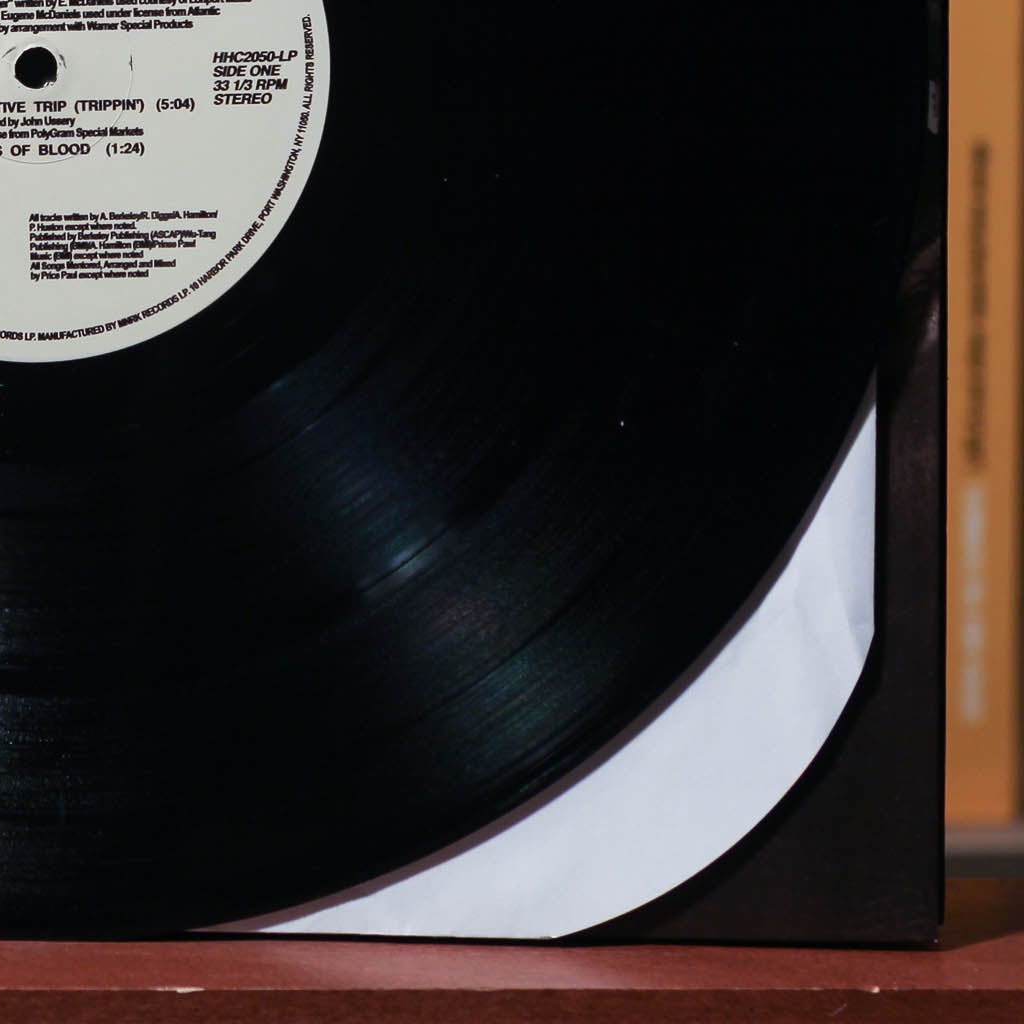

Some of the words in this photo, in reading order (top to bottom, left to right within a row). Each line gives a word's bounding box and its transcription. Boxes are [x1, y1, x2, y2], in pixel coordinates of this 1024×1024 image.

[1, 10, 35, 22] Eugene
[36, 9, 81, 20] McDaniels
[83, 9, 104, 18] used
[106, 8, 132, 18] under
[133, 7, 164, 17] license
[165, 7, 186, 17] from
[187, 6, 221, 16] Atlantic
[10, 22, 66, 34] arrangement
[67, 21, 85, 31] with
[87, 21, 119, 31] Warner
[120, 19, 152, 32] Special
[153, 19, 193, 29] Products
[302, 14, 315, 60] RESERVED.
[212, 50, 298, 64] HHC2050-LP
[212, 65, 247, 77] SIDE
[249, 64, 281, 76] ONE
[304, 61, 315, 93] RIGHTS
[212, 80, 231, 92] 33
[234, 79, 253, 91] 1/3
[255, 78, 288, 91] RPM
[33, 100, 67, 113] TRIP
[74, 98, 145, 114] (TRIPPIN')
[155, 97, 195, 112] (5:04)
[213, 93, 273, 106] STEREO
[302, 93, 313, 110] ALL
[8, 117, 20, 129] by
[20, 116, 43, 127] John
[44, 116, 76, 127] Ussery
[8, 129, 29, 139] from
[31, 128, 74, 141] PolyGram
[76, 128, 107, 139] Special
[109, 127, 144, 137] Markets
[293, 134, 305, 147] NY
[10, 144, 31, 156] OF
[38, 143, 91, 156] BLOOD
[106, 142, 145, 156] (1:24)
[270, 148, 302, 201] WASHINGTON,
[89, 212, 99, 223] by
[100, 212, 108, 220] A.
[258, 199, 276, 222] PORT
[67, 232, 77, 243] by
[241, 220, 264, 244] DRIVE,
[225, 240, 246, 263] PARK
[31, 271, 40, 282] by
[197, 258, 229, 286] HARBOR
[178, 287, 192, 300] LP.
[141, 294, 179, 318] RECORDS
[38, 324, 105, 341] MANUFACTURED
[105, 321, 117, 332] BY
[26, 332, 37, 341] LP.
